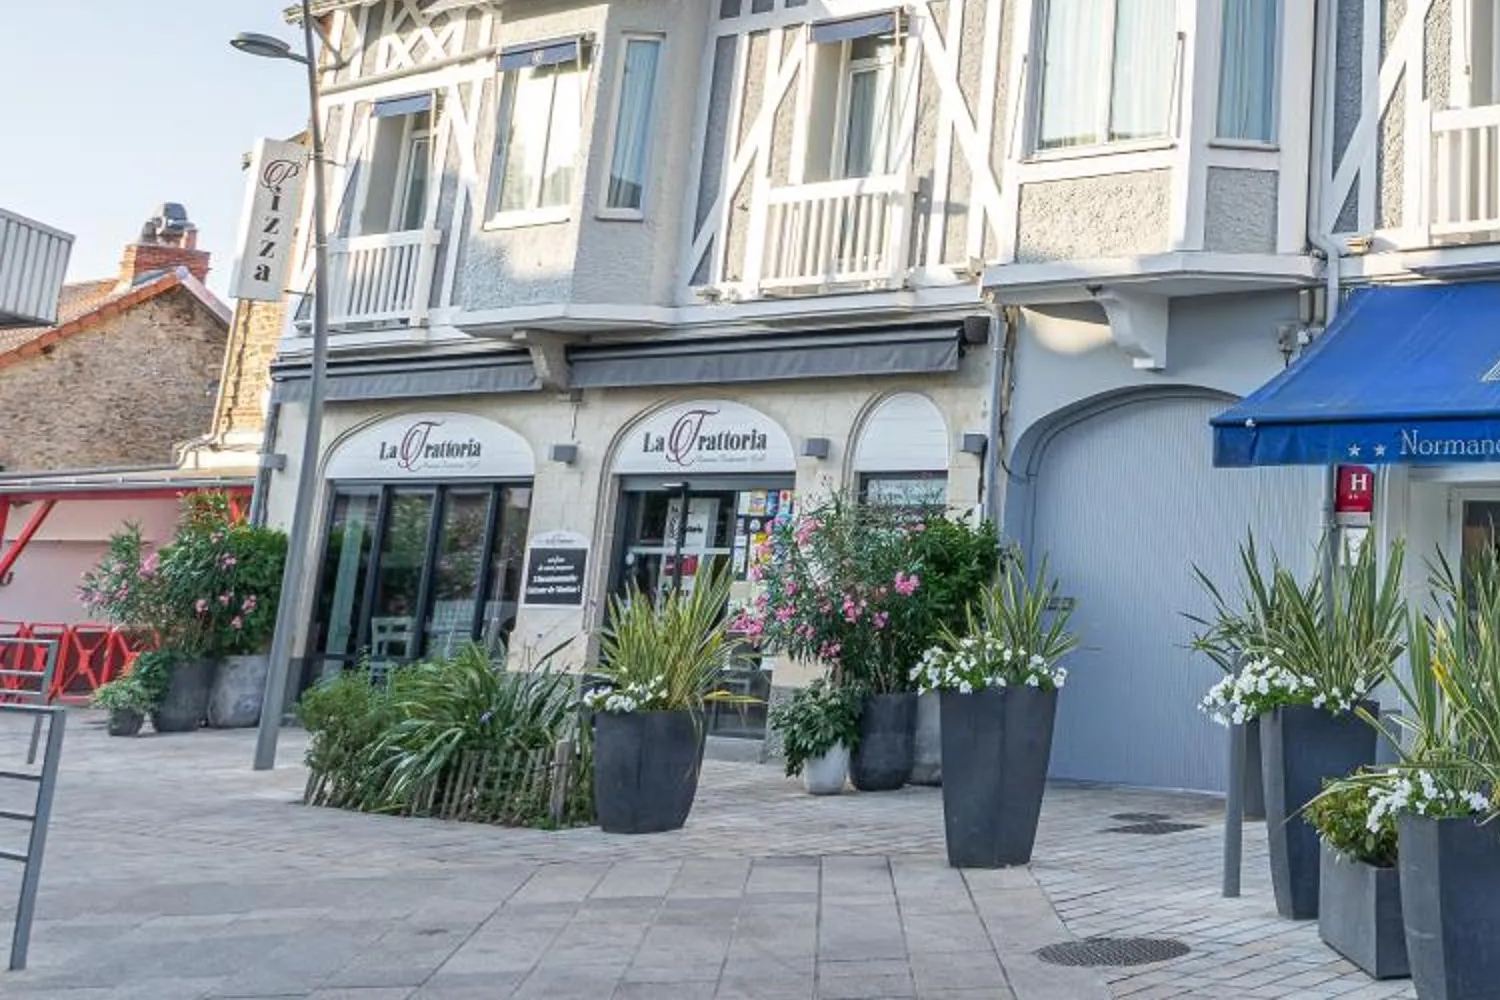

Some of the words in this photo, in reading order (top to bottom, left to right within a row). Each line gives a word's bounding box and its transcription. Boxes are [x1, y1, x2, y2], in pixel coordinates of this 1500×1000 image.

[253, 160, 302, 282] Pizza
[379, 441, 397, 460] La
[398, 421, 482, 472] Trattoria
[643, 432, 664, 453] La
[666, 409, 767, 466] Trattoria
[1350, 473, 1368, 491] H
